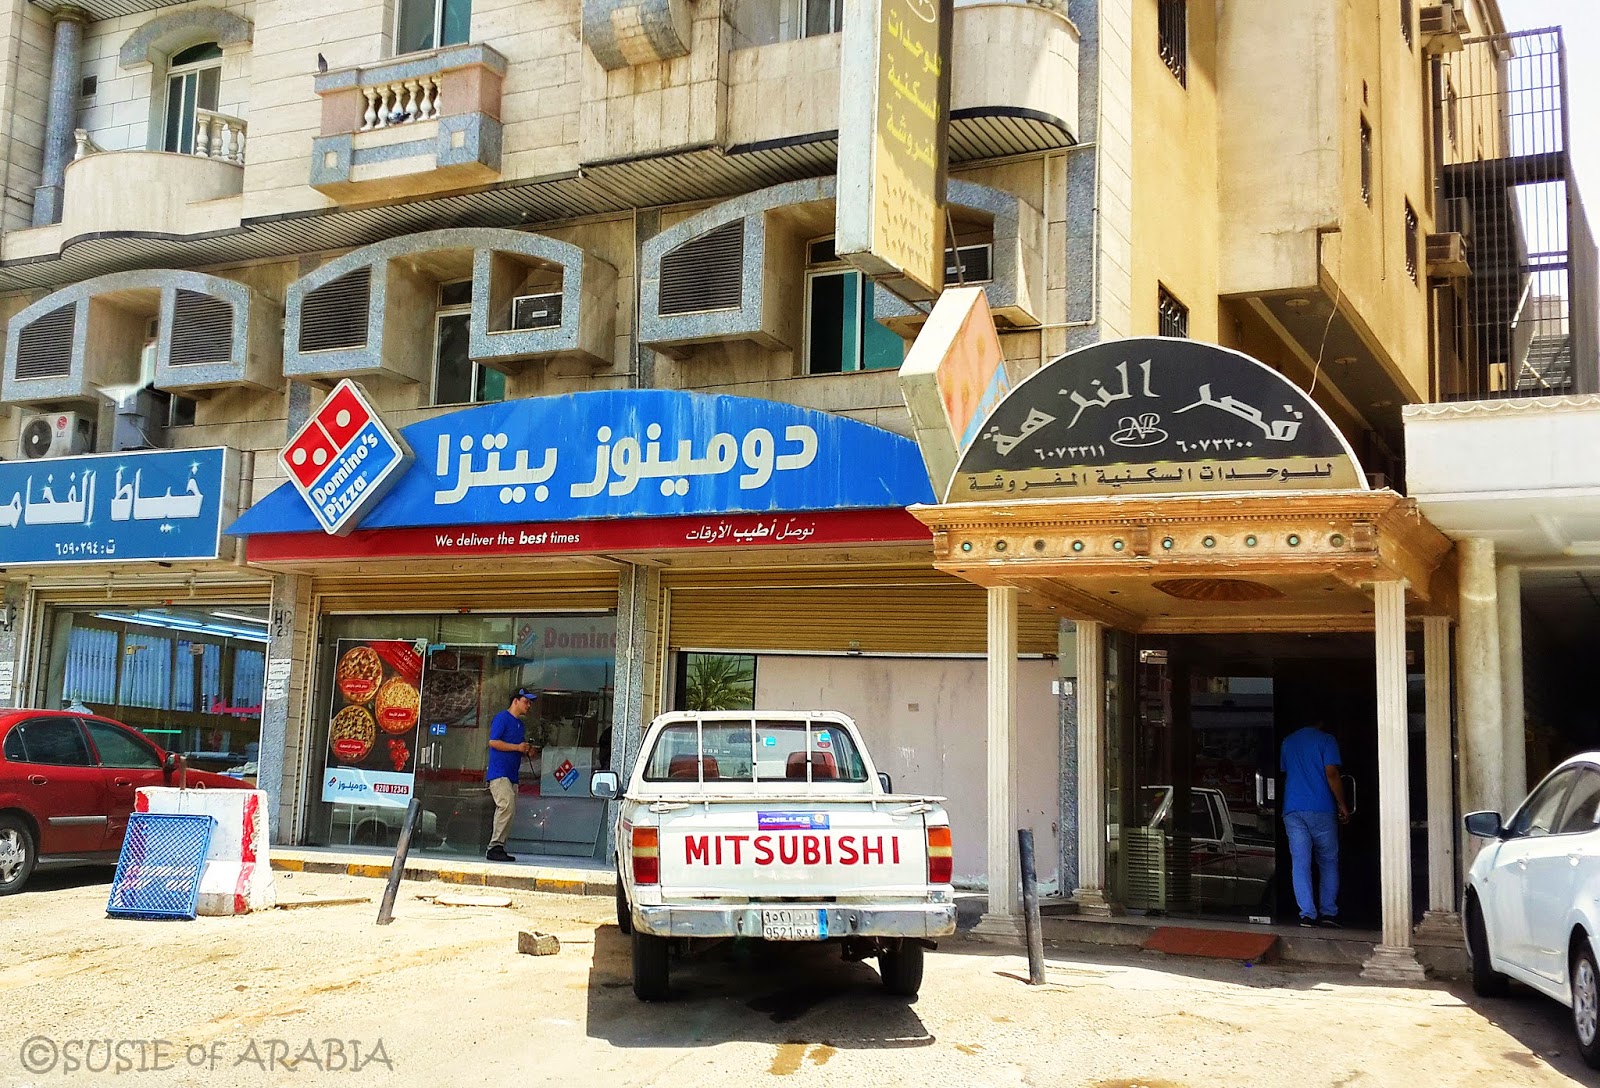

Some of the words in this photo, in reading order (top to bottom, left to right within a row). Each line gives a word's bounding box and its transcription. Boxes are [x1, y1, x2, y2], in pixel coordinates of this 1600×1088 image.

[982, 359, 1160, 456] النزهة
[1173, 383, 1303, 442] قصر
[1034, 444, 1105, 460] ٦٠٧٣٣١١
[1176, 438, 1253, 452] ٦٠٧٣٣٠٠
[312, 432, 379, 506] Domino's
[434, 433, 558, 505] بيتزا
[570, 422, 818, 497] دومينوز
[968, 472, 1087, 492] المفروشة
[1097, 467, 1191, 488] السكنية
[1200, 463, 1333, 482] للوحدات
[0, 468, 97, 529] الفخام
[111, 464, 204, 533] خياط
[435, 534, 453, 547] We
[456, 533, 494, 546] deliver
[497, 531, 515, 545] the
[519, 531, 547, 545] best
[550, 531, 580, 544] times
[685, 520, 732, 543] الأوقات
[733, 518, 777, 542] أطيب
[685, 835, 900, 866] MITSUBISHI
[765, 927, 793, 939] 9521
